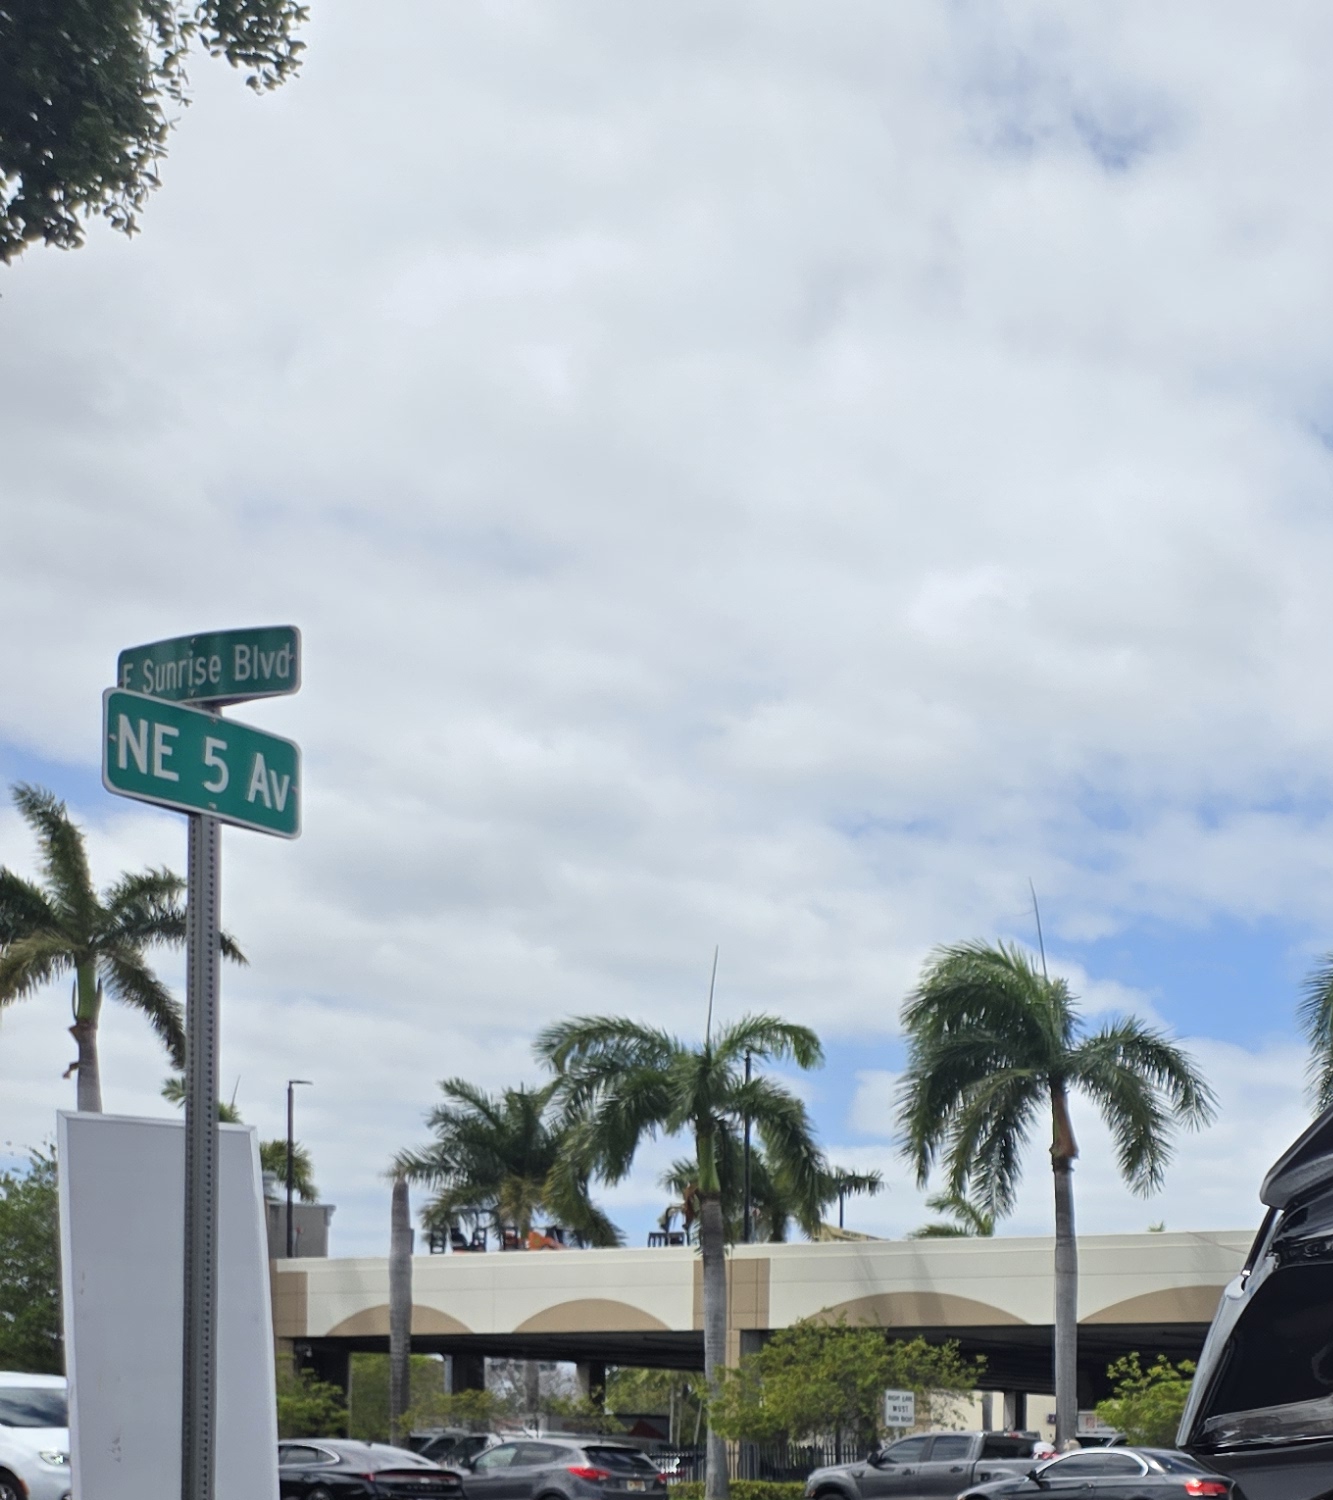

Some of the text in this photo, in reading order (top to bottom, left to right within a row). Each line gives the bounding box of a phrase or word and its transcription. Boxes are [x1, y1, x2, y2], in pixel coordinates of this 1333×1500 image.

[143, 651, 221, 694] Sunrise
[234, 643, 290, 682] Blvd
[118, 713, 290, 812] NE 5 Av
